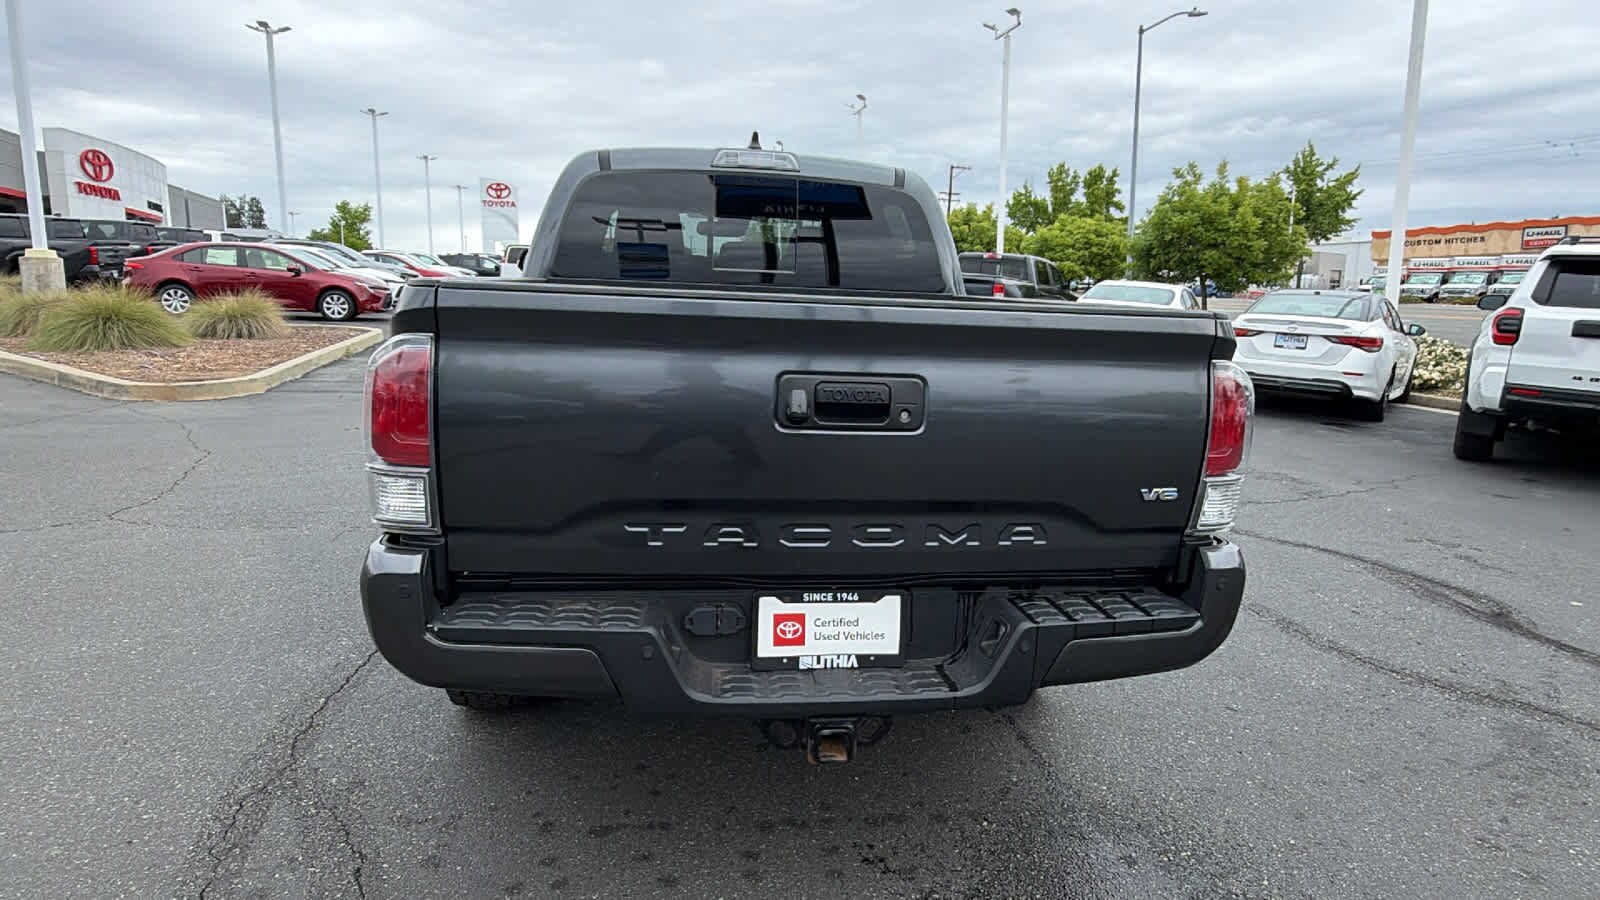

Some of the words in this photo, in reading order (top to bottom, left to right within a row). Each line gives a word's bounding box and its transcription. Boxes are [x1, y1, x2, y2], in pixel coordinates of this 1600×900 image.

[74, 181, 121, 201] TOYOTA
[482, 200, 517, 208] TOYOTA
[1526, 229, 1562, 237] U-HAUL
[1404, 239, 1441, 247] CUSTOM
[1444, 236, 1485, 245] HITCHES
[823, 387, 886, 402] TOYOTA
[1140, 487, 1178, 501] V6
[624, 523, 1047, 548] TACOMA
[803, 593, 832, 602] SINCE
[836, 593, 859, 602] 1946
[813, 618, 859, 628] Certified
[813, 632, 840, 641] Used
[843, 631, 885, 641] Vehicles
[812, 655, 858, 669] LITHIA
